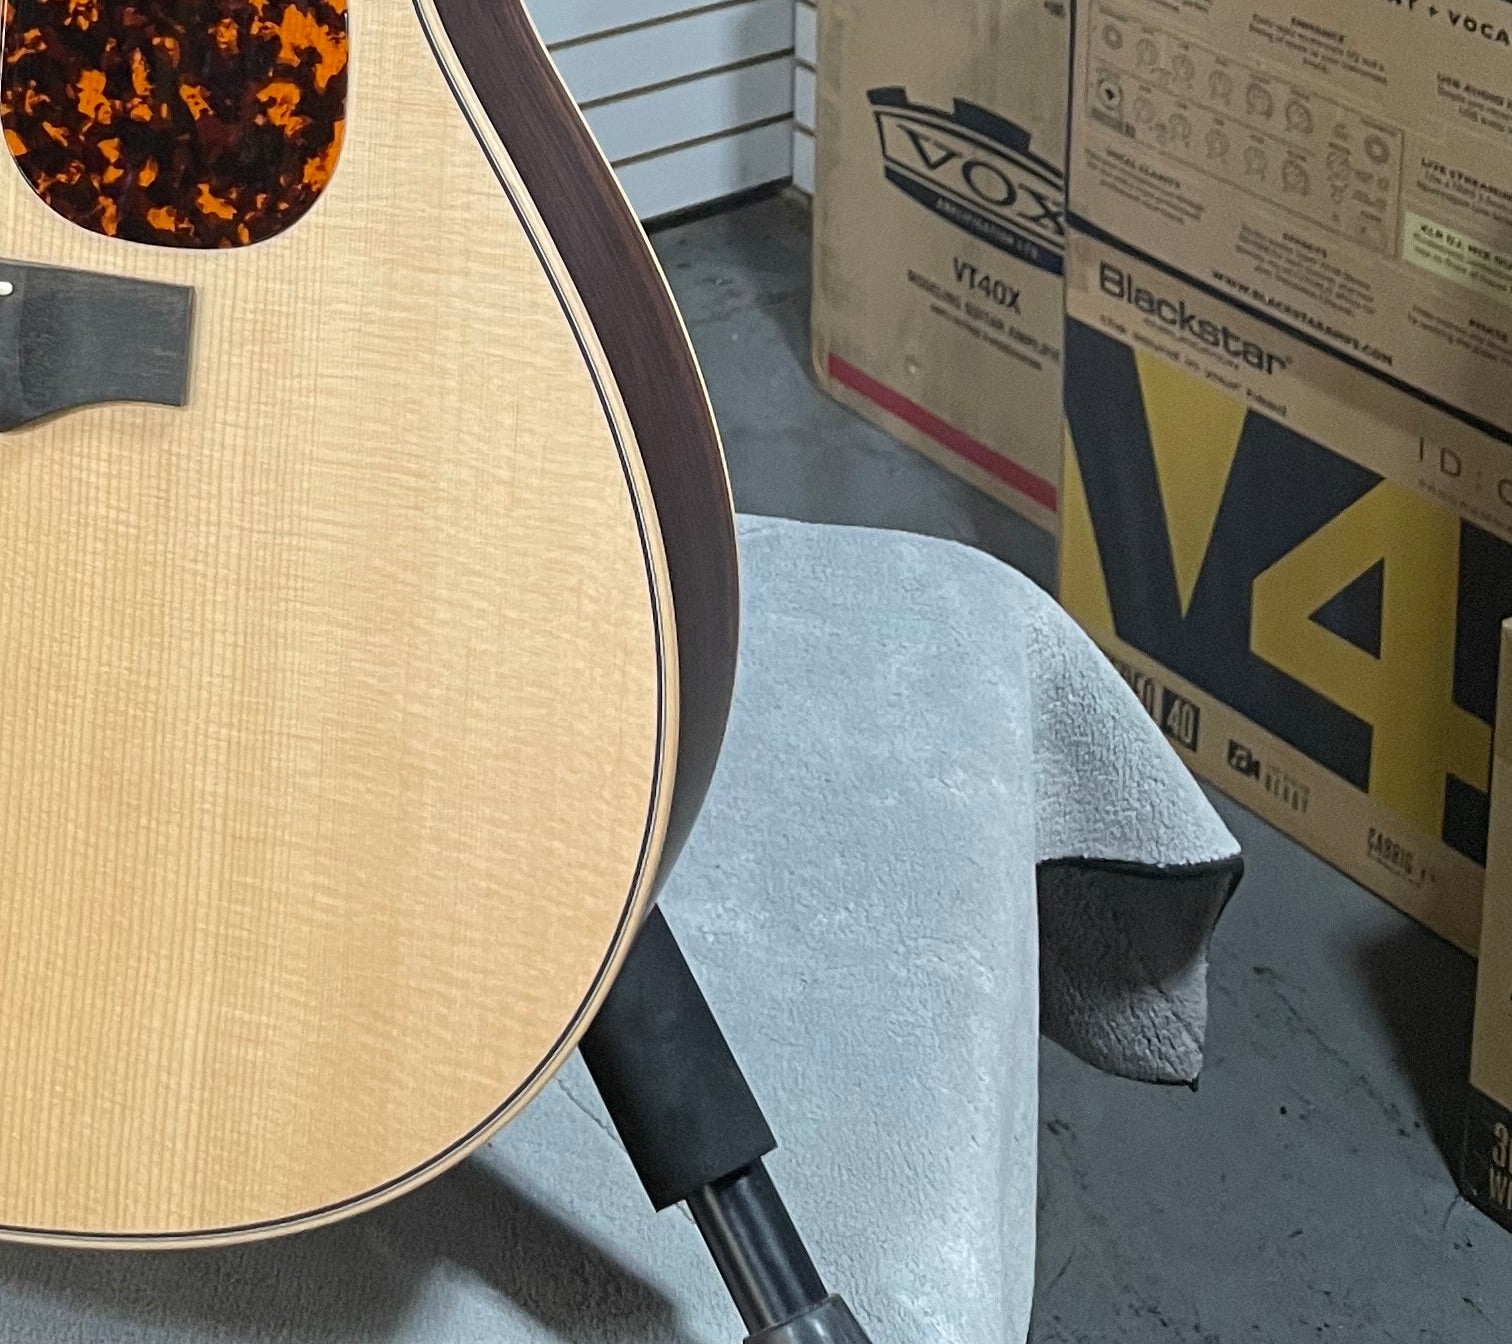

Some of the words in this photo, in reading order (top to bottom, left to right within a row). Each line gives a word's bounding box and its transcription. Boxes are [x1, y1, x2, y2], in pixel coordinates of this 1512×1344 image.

[897, 123, 1065, 236] VOX
[953, 256, 1021, 315] VT40X
[1099, 260, 1289, 375] Blackstar
[1166, 698, 1196, 744] 40
